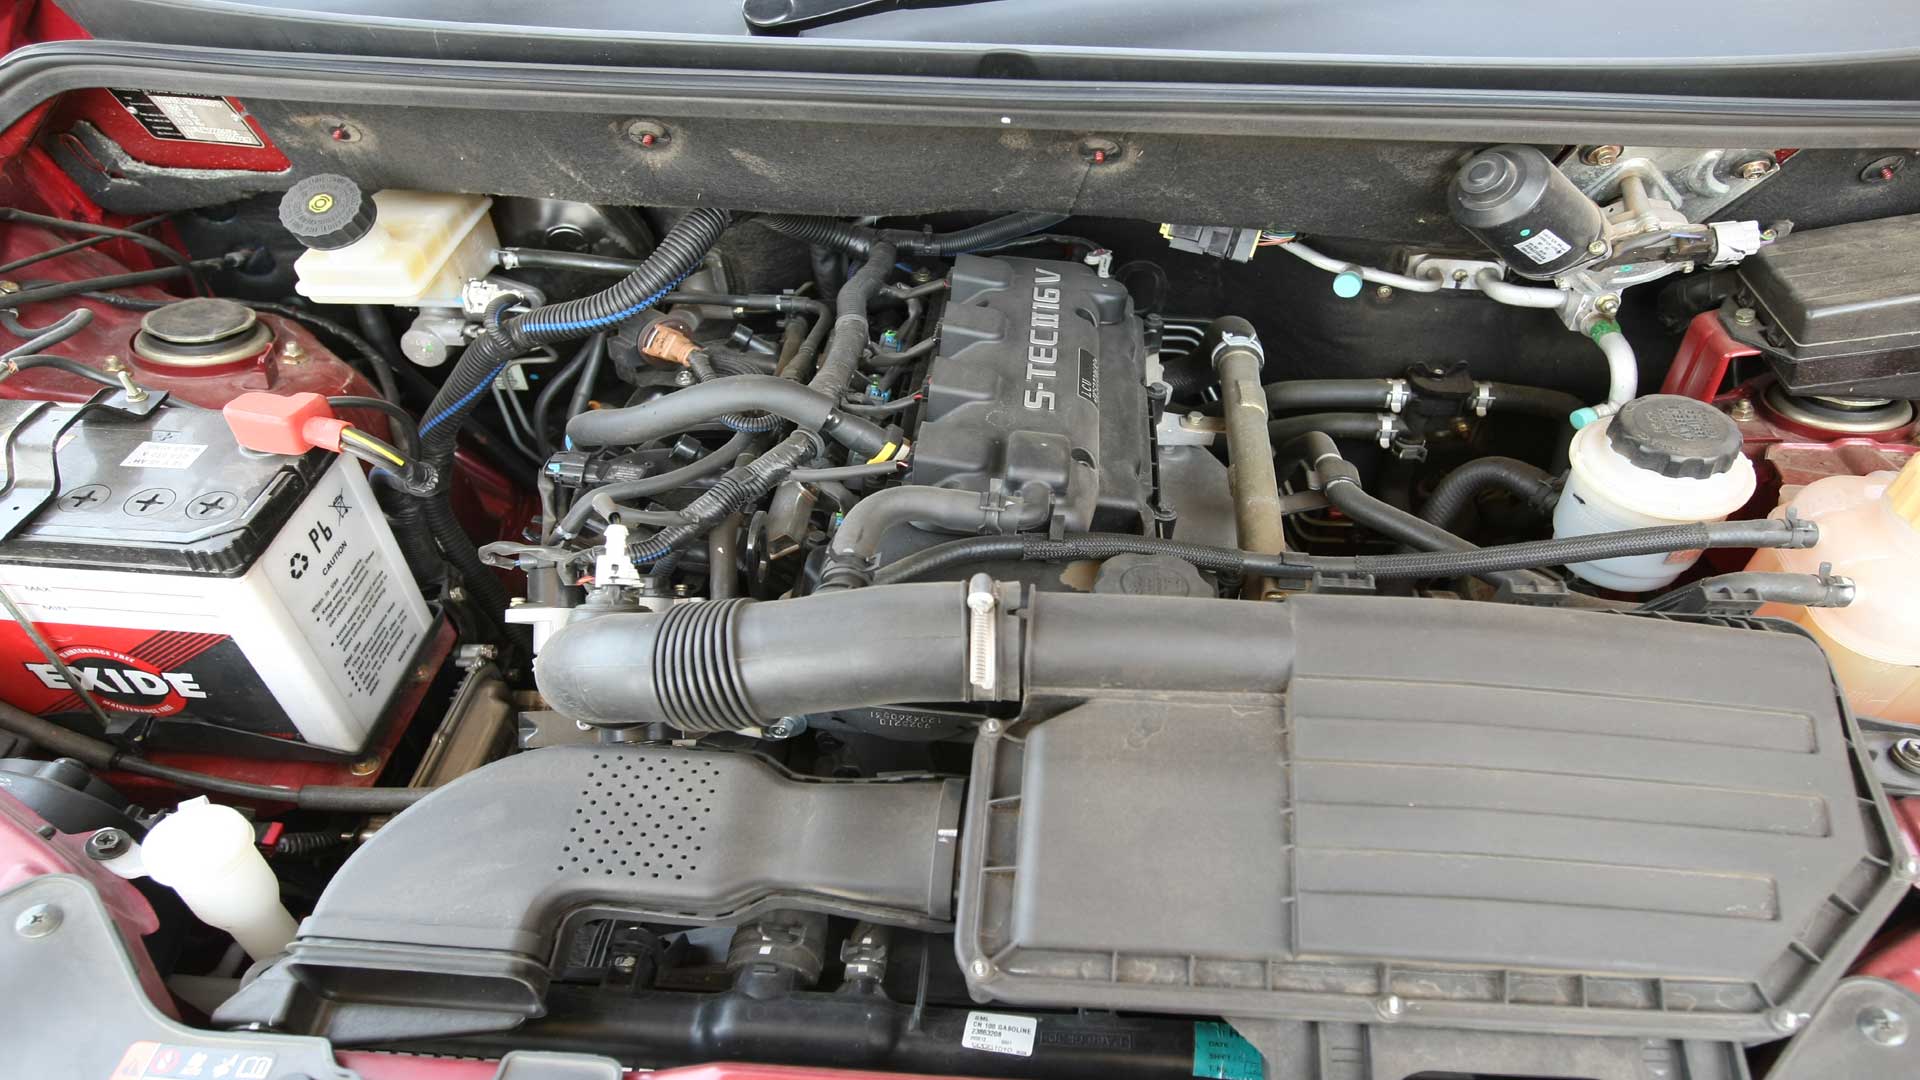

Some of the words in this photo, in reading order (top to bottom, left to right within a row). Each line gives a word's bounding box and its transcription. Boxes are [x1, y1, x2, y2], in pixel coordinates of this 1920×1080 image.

[308, 520, 333, 554] Pb
[321, 540, 348, 577] CAUTION
[24, 662, 208, 699] EXIDE
